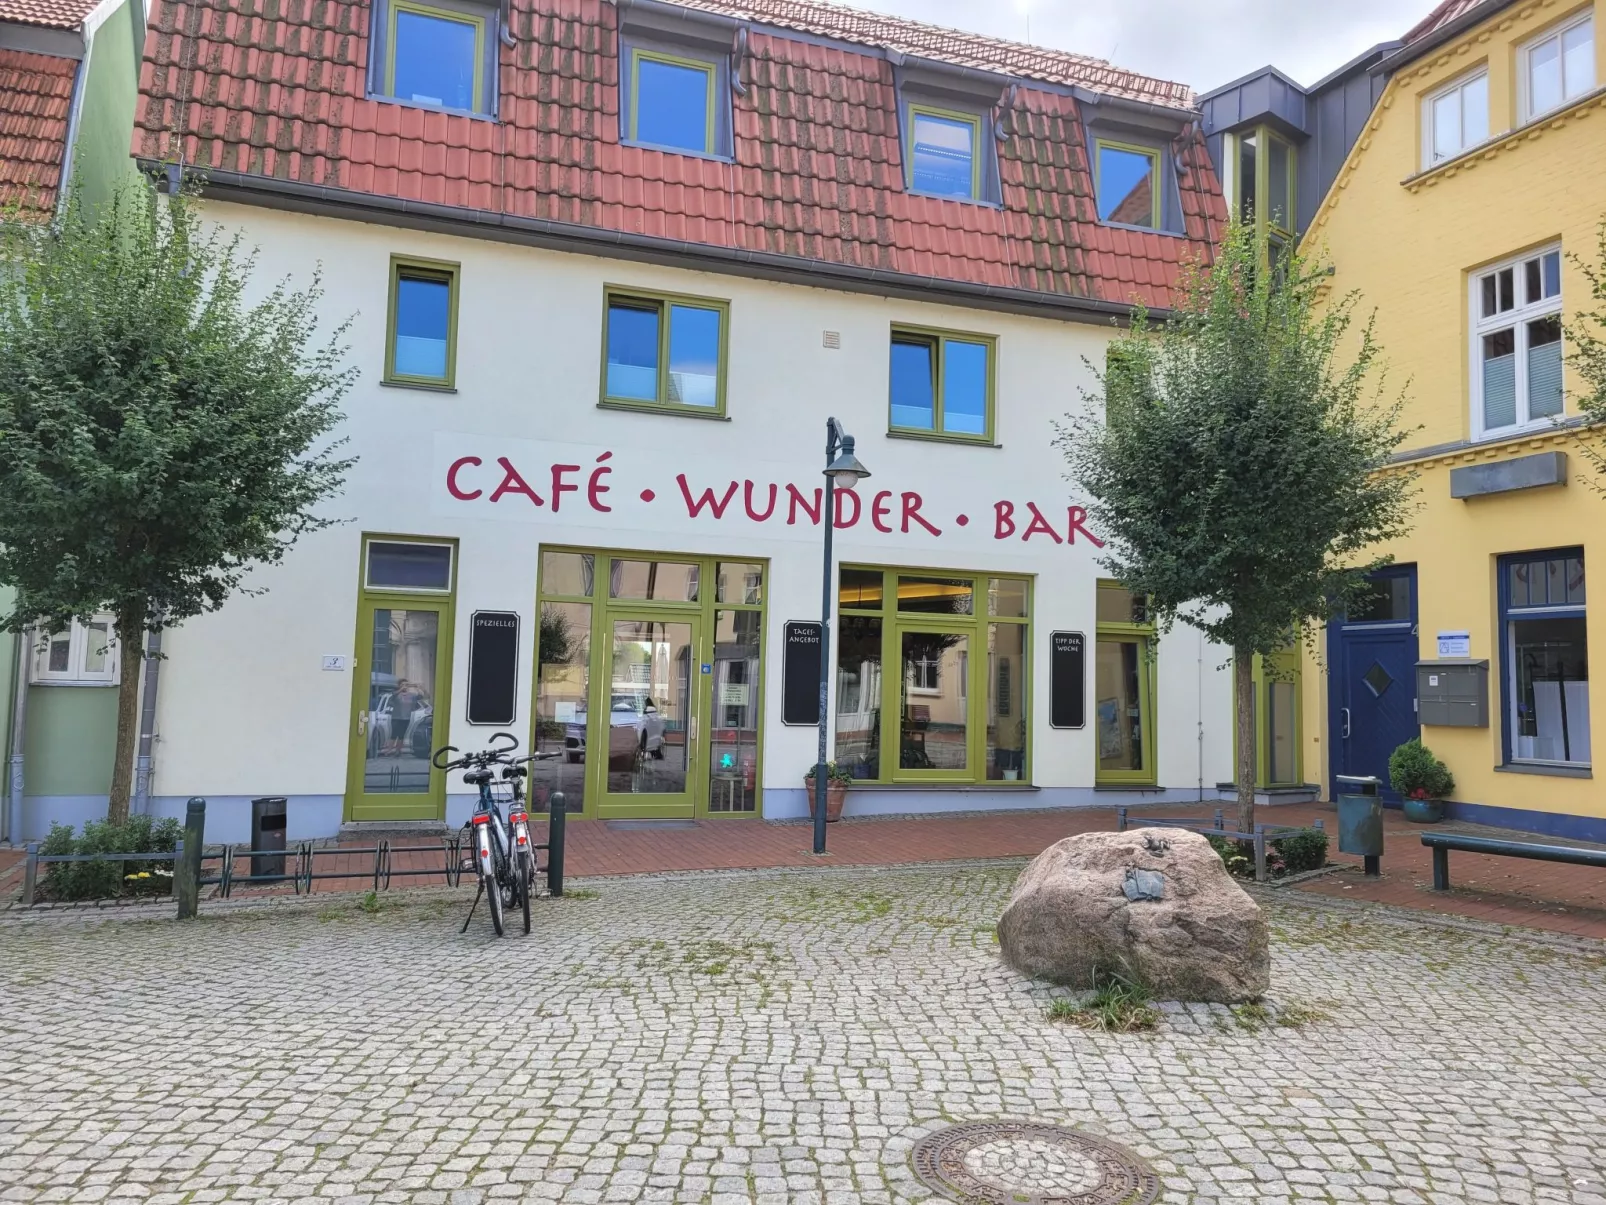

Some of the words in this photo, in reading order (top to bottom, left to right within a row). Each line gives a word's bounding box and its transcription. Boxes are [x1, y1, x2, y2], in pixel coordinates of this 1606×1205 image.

[447, 451, 612, 513] CAFÉ
[676, 473, 942, 537] WUNDER
[994, 500, 1106, 549] BAR
[476, 619, 515, 628] SPEZIELLES
